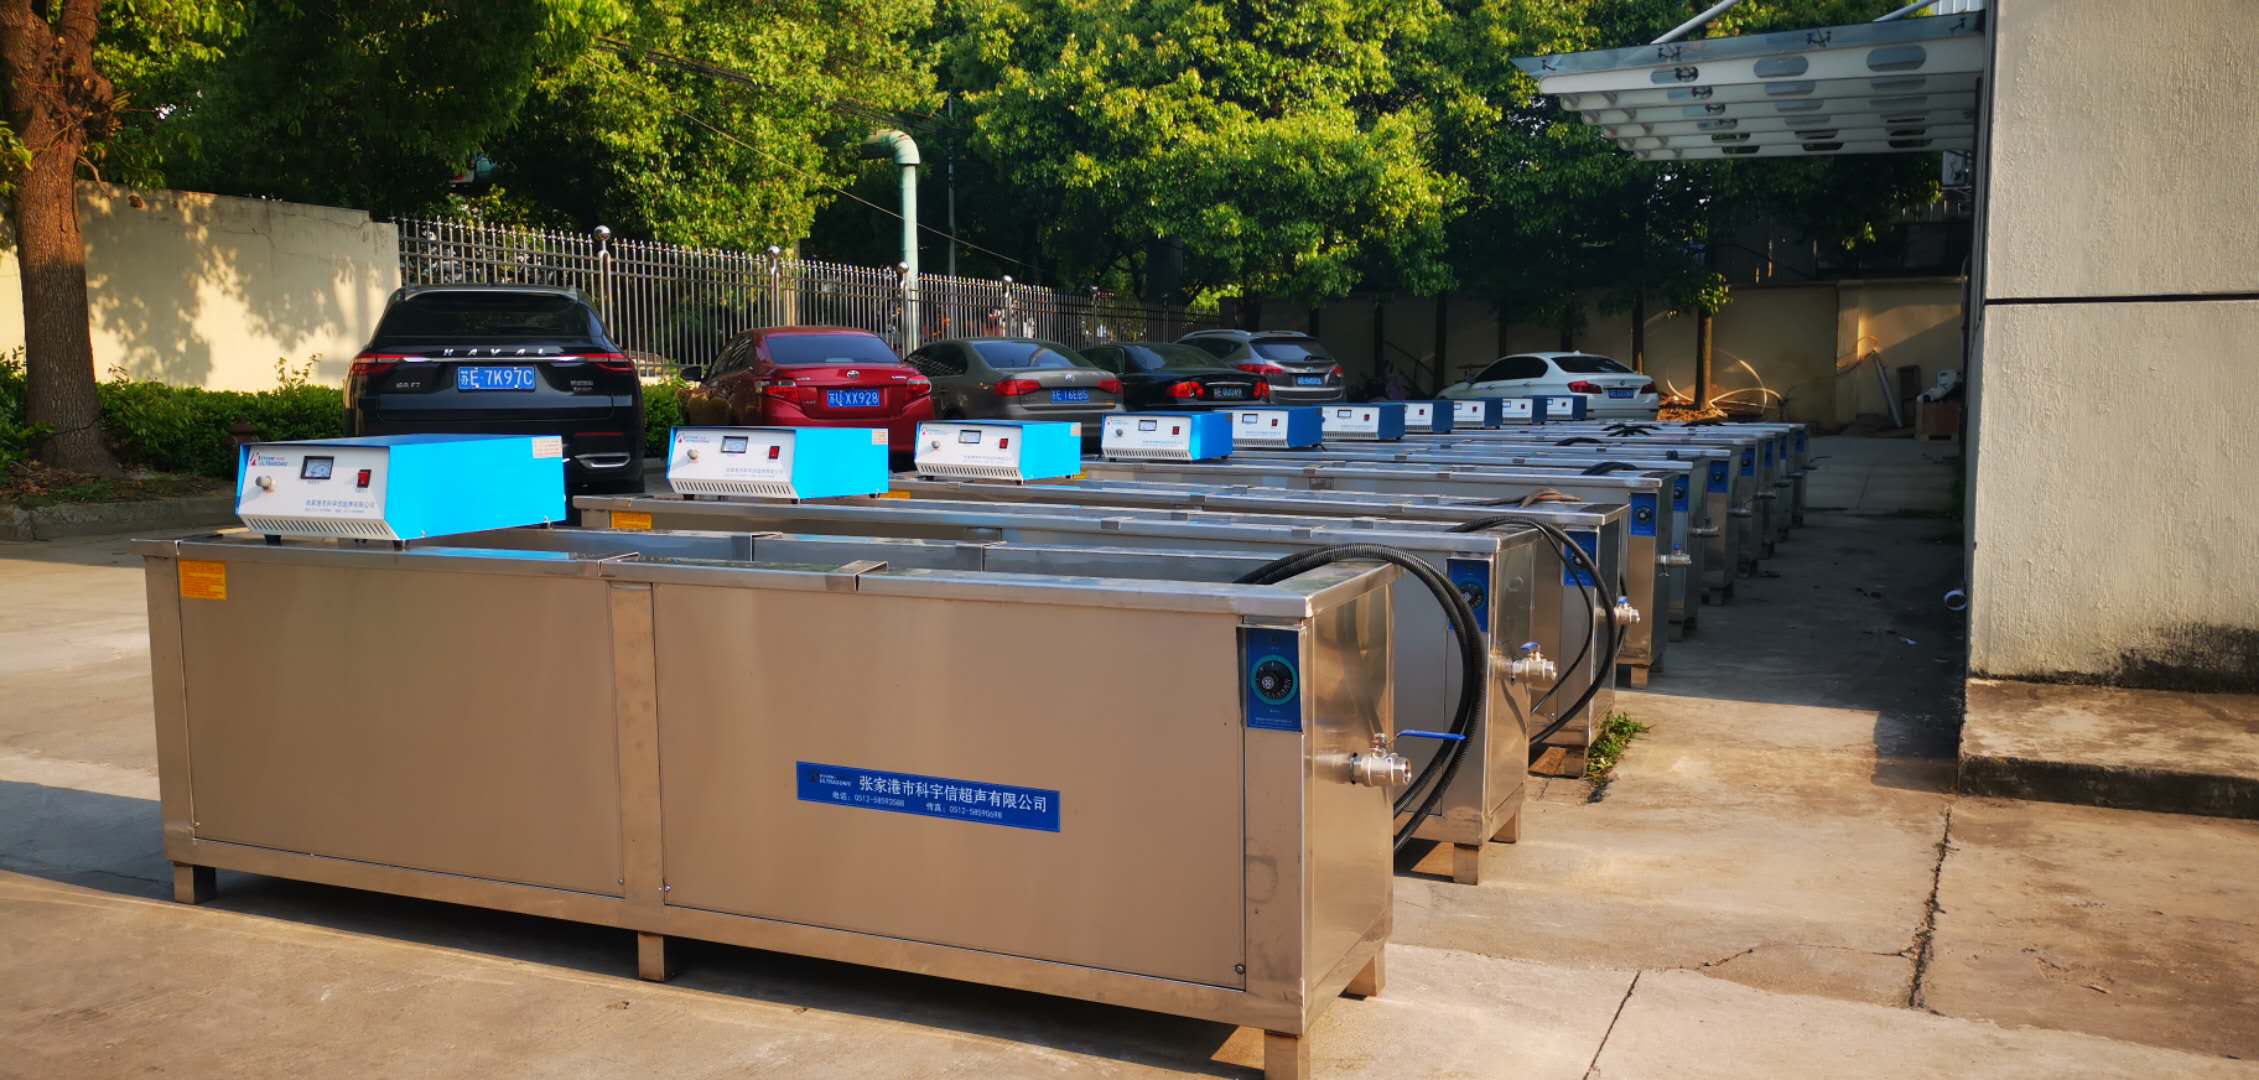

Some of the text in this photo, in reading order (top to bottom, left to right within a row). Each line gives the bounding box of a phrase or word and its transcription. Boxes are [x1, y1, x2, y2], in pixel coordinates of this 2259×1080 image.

[859, 775, 1047, 813] 张家港市科宇信超声有限公司
